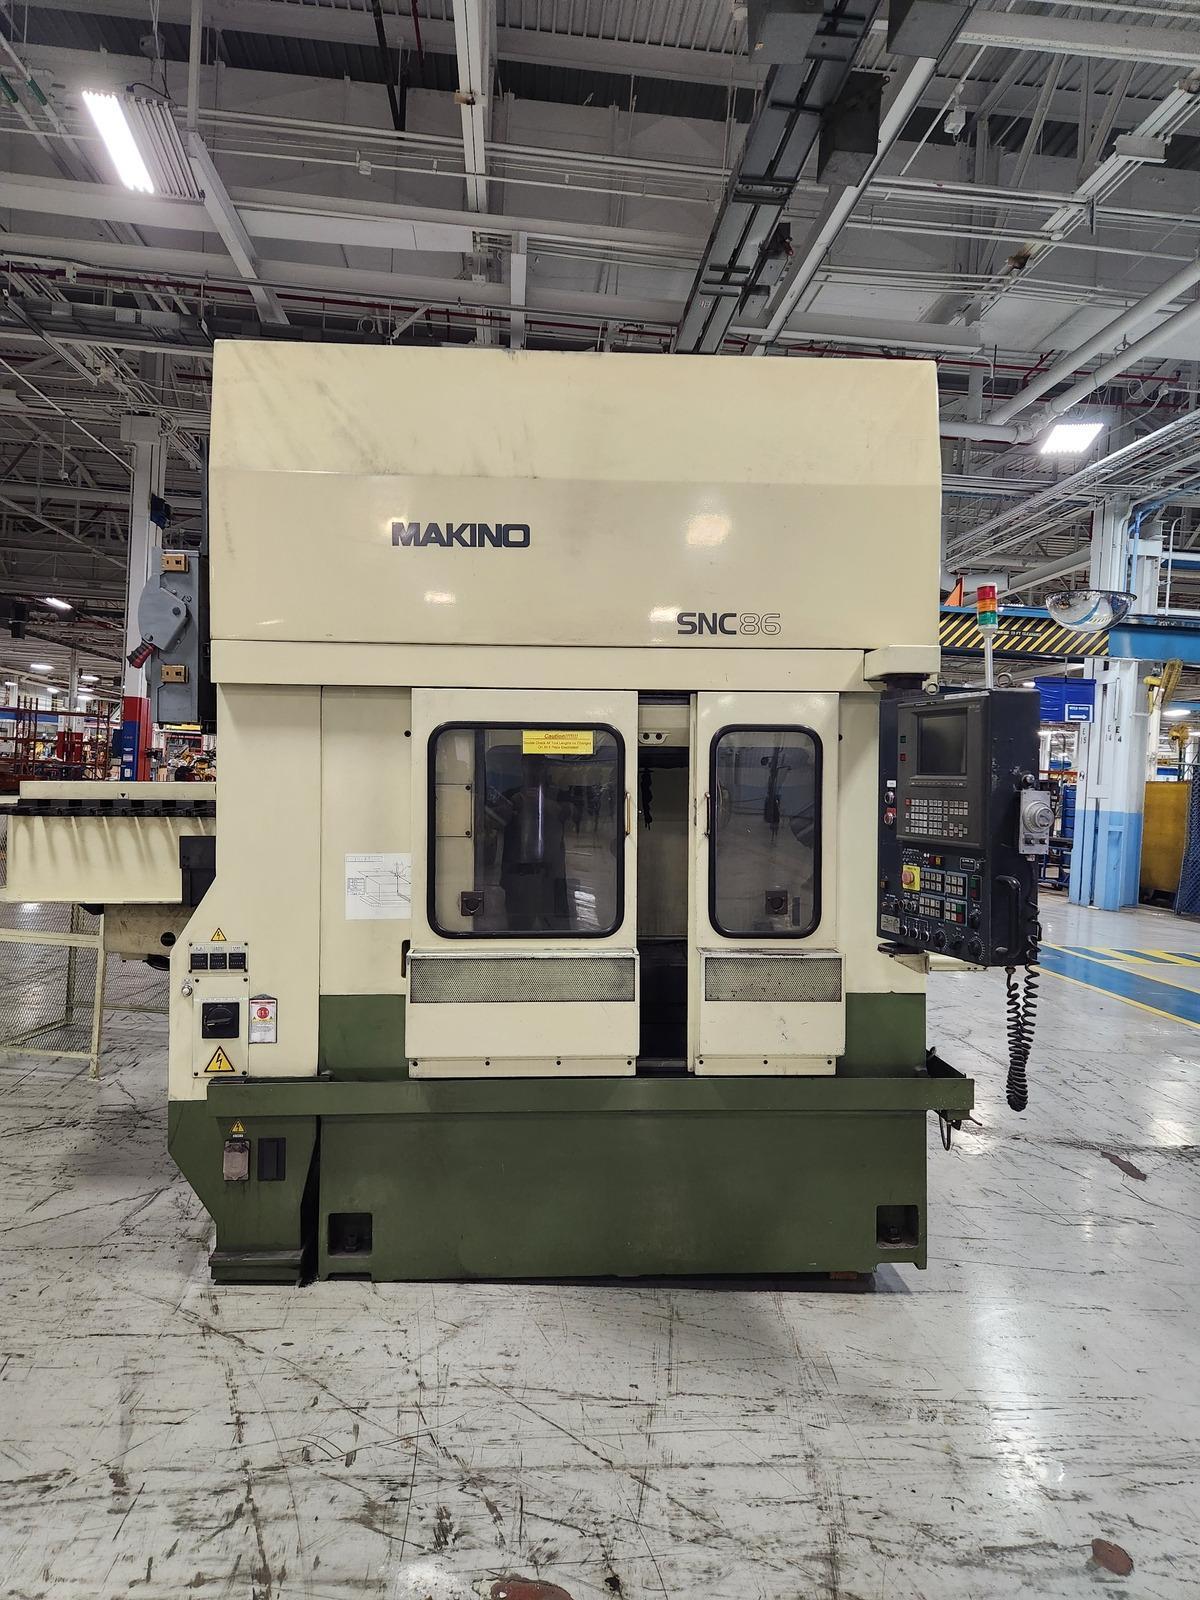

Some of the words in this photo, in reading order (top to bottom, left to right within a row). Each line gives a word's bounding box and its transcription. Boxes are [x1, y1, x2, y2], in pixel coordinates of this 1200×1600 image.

[391, 522, 530, 547] MAKINO
[677, 612, 782, 636] SNC86
[1115, 726, 1121, 734] E
